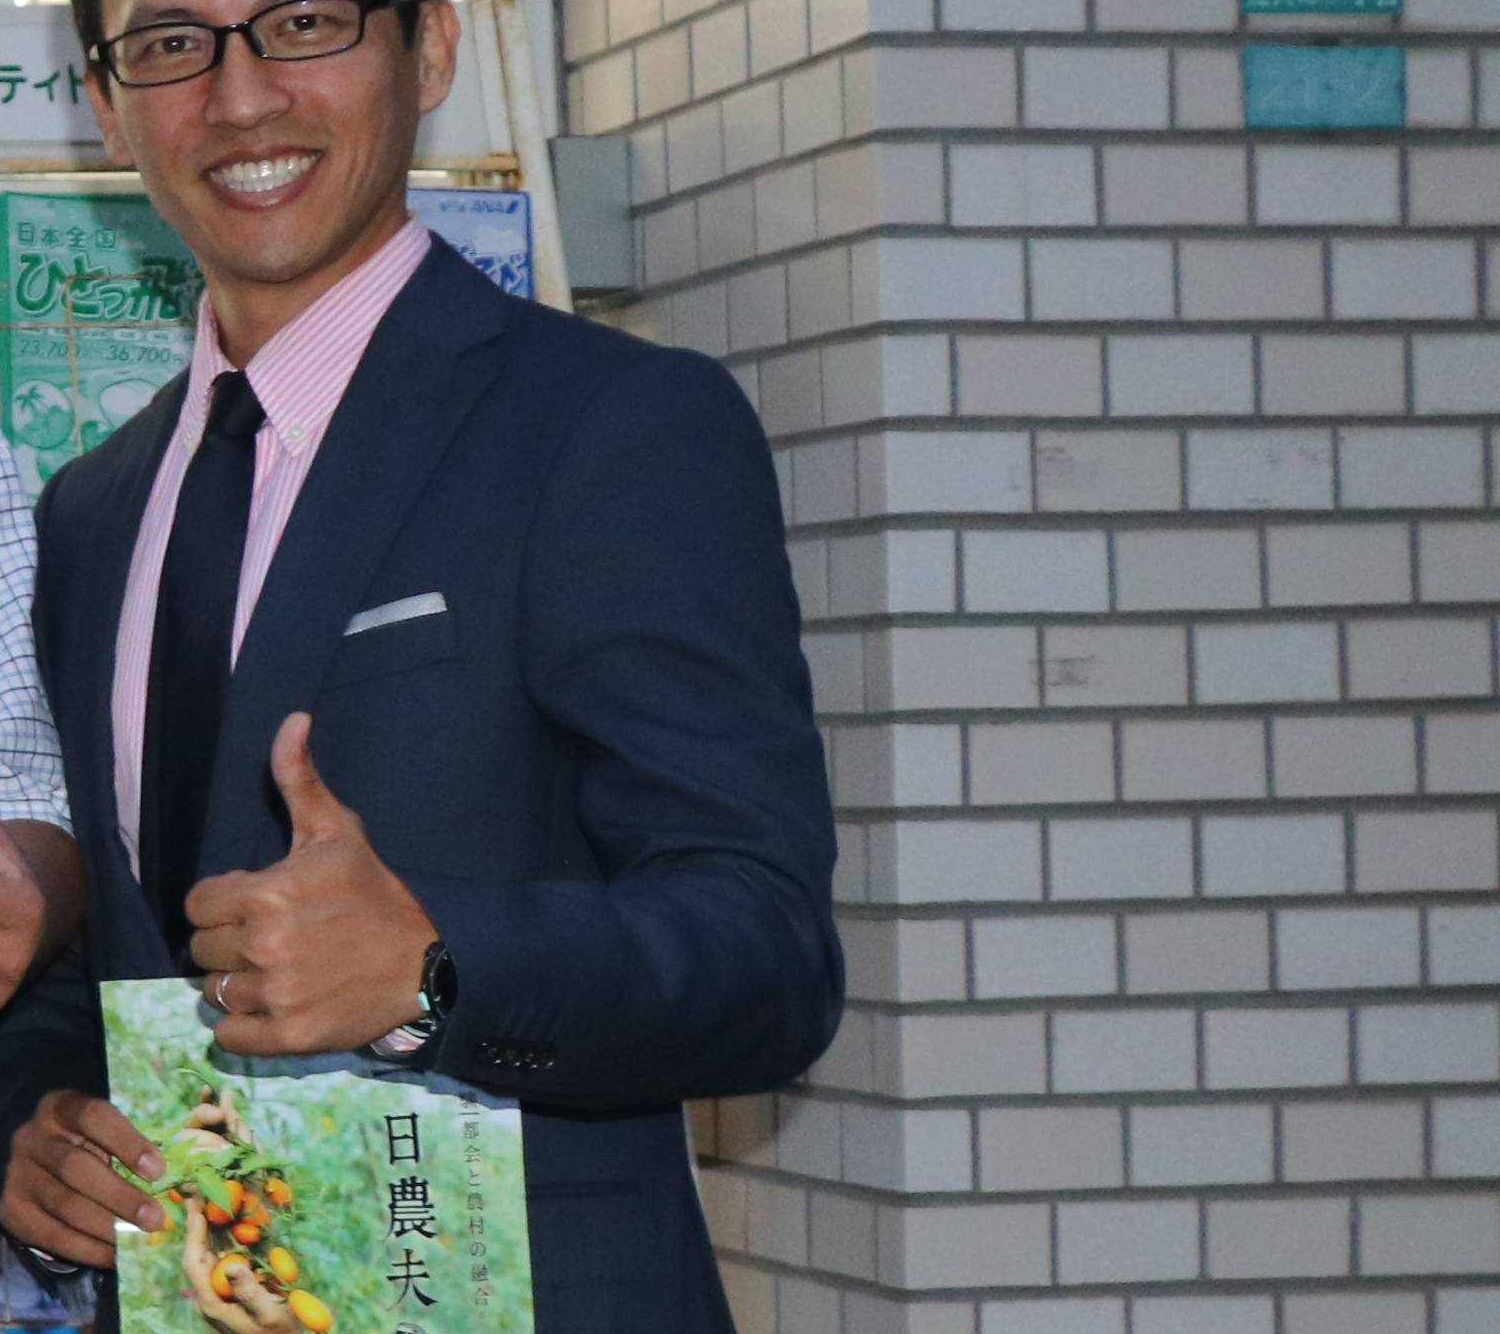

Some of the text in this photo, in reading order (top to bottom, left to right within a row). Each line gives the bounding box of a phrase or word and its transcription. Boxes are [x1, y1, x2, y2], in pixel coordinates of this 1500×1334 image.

[18, 222, 117, 251] 日本全国
[16, 251, 207, 323] ひとつ飛
